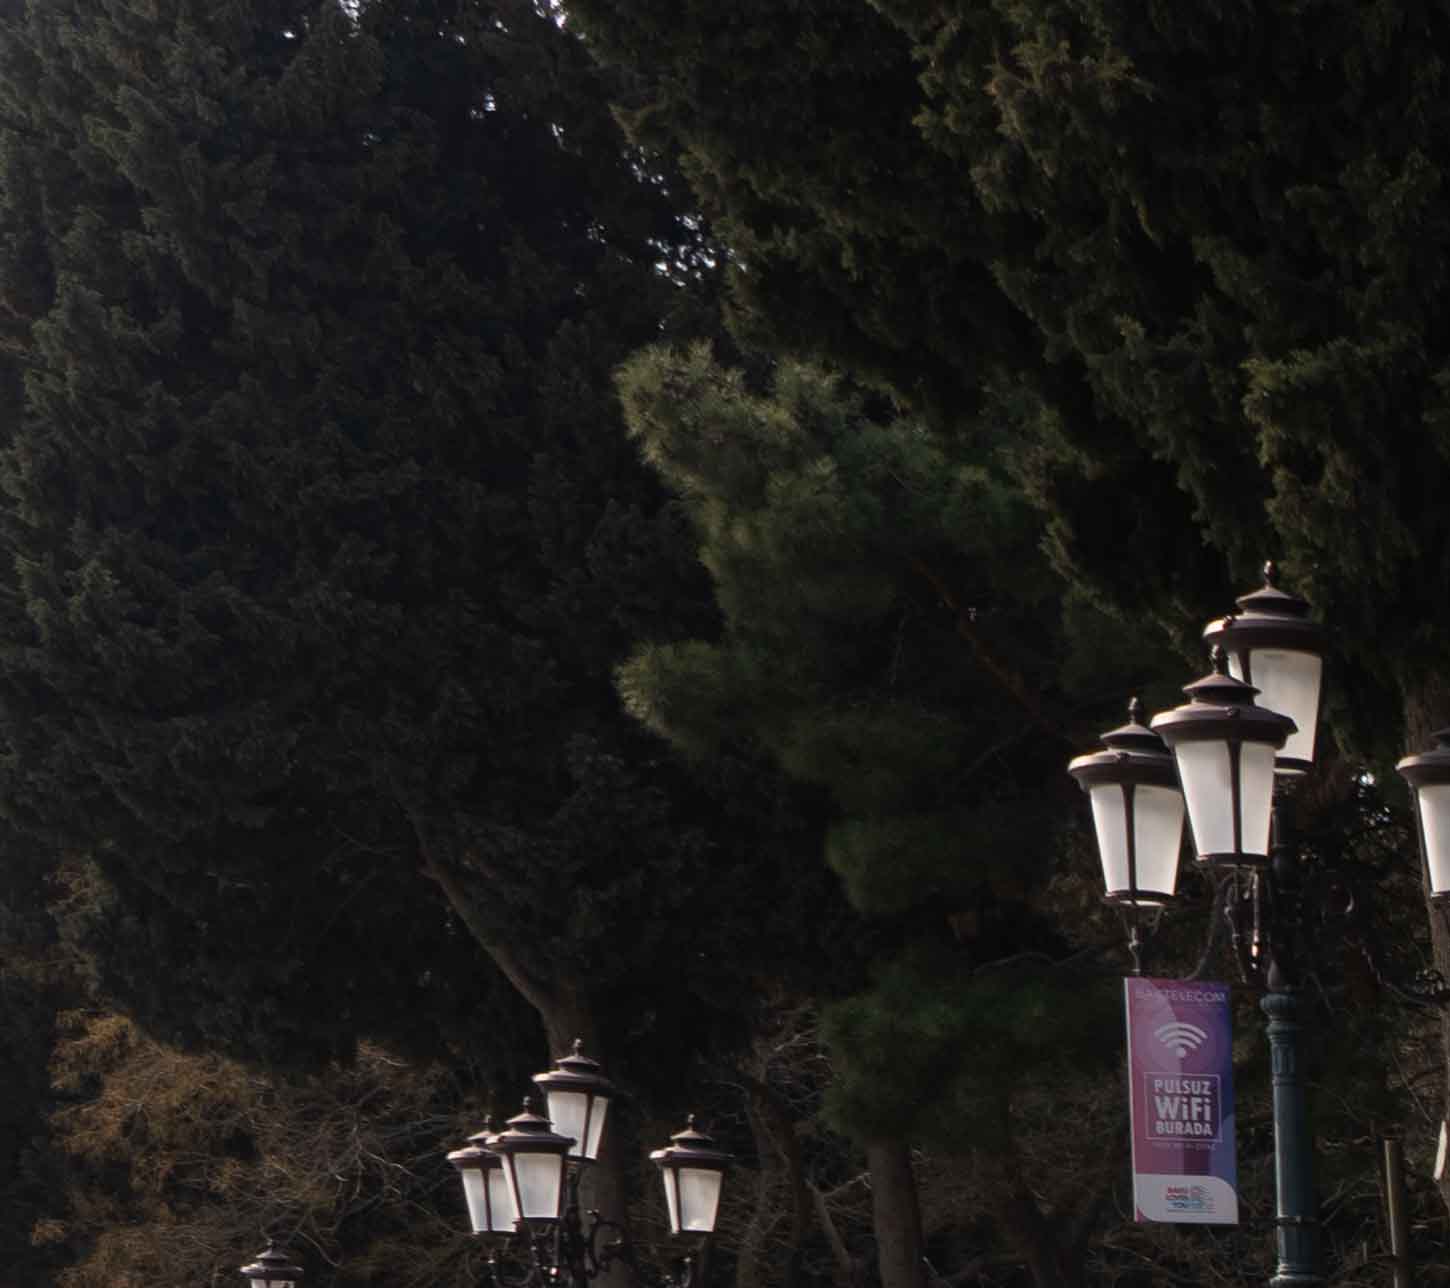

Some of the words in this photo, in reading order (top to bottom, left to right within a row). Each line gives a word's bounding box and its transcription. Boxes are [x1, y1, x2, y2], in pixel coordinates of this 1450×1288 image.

[1154, 1079, 1212, 1095] PULSUZ
[1155, 1095, 1212, 1121] WiFi
[1156, 1121, 1213, 1136] BURADA
